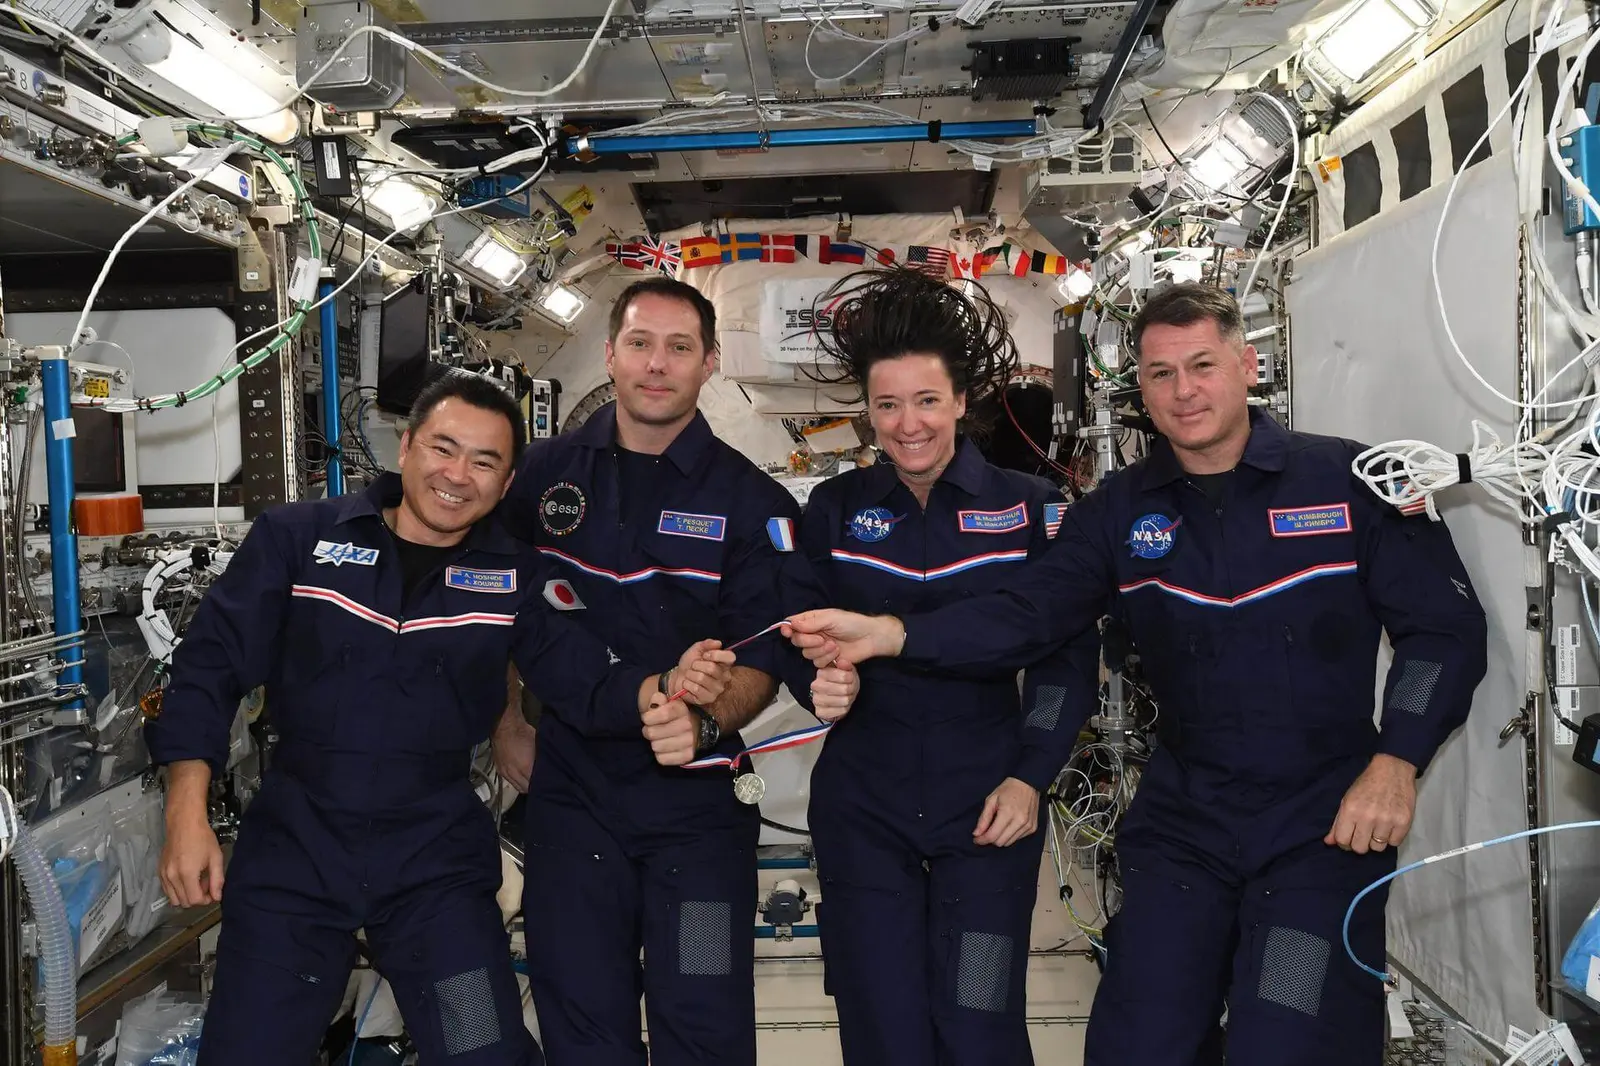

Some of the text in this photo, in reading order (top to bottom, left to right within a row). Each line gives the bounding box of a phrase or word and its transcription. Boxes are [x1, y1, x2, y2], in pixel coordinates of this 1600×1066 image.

[558, 504, 579, 515] esa
[1298, 511, 1343, 521] KIMBROUGH
[682, 518, 715, 528] PESQUET
[854, 515, 890, 532] NASA
[1133, 530, 1172, 542] NASA
[319, 543, 376, 564] JAXA
